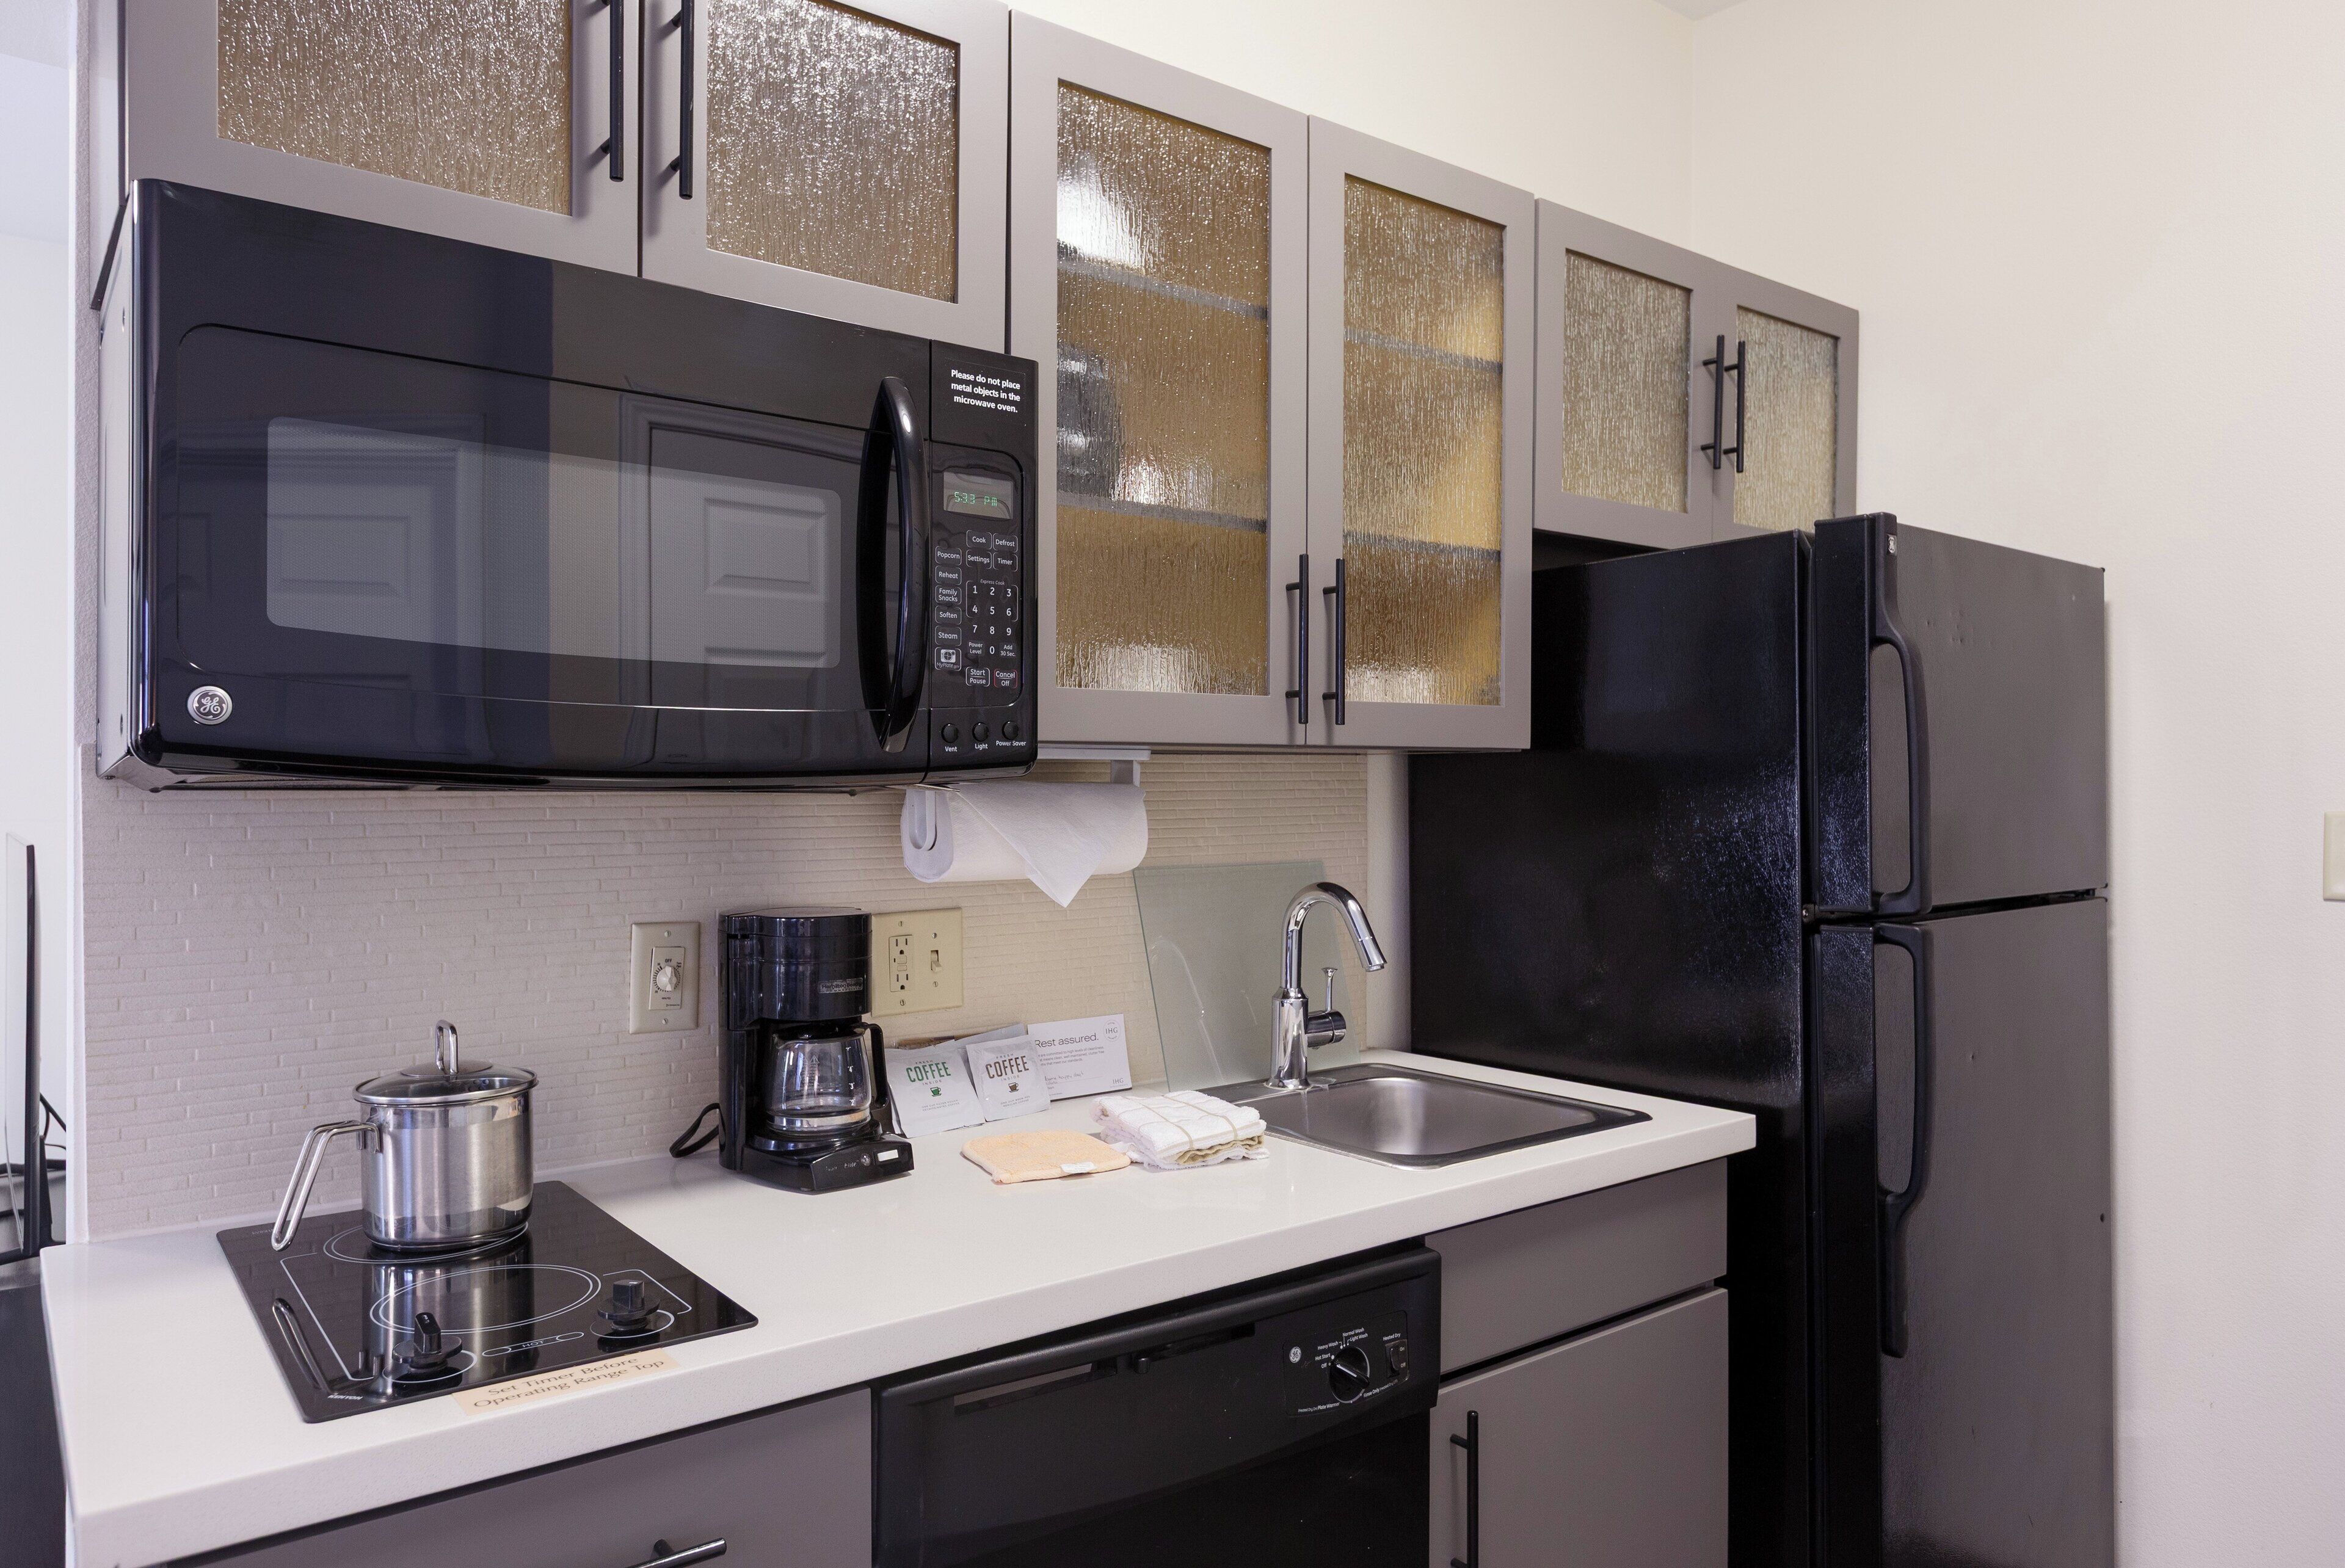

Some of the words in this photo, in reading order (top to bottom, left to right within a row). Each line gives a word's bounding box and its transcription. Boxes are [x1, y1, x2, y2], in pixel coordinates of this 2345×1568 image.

[951, 369, 974, 381] Please
[1002, 380, 1020, 390] place
[951, 382, 972, 393] metal
[973, 386, 998, 397] objects
[1000, 391, 1007, 399] in
[1008, 392, 1020, 401] the
[954, 396, 995, 408] microwave
[997, 404, 1017, 413] oven.
[995, 539, 1015, 547] Defrost
[968, 555, 990, 564] Settings
[1035, 1039, 1056, 1048] Rest
[1058, 1033, 1099, 1045] assured.
[906, 1062, 951, 1083] COFFEE
[986, 1055, 1029, 1079] COFFEE
[522, 1340, 545, 1348] HOT
[474, 1381, 571, 1408] Operating
[575, 1368, 630, 1385] Range
[634, 1359, 664, 1371] Top
[489, 1385, 517, 1396] Set
[522, 1372, 575, 1388] Timer
[581, 1357, 638, 1375] Before
